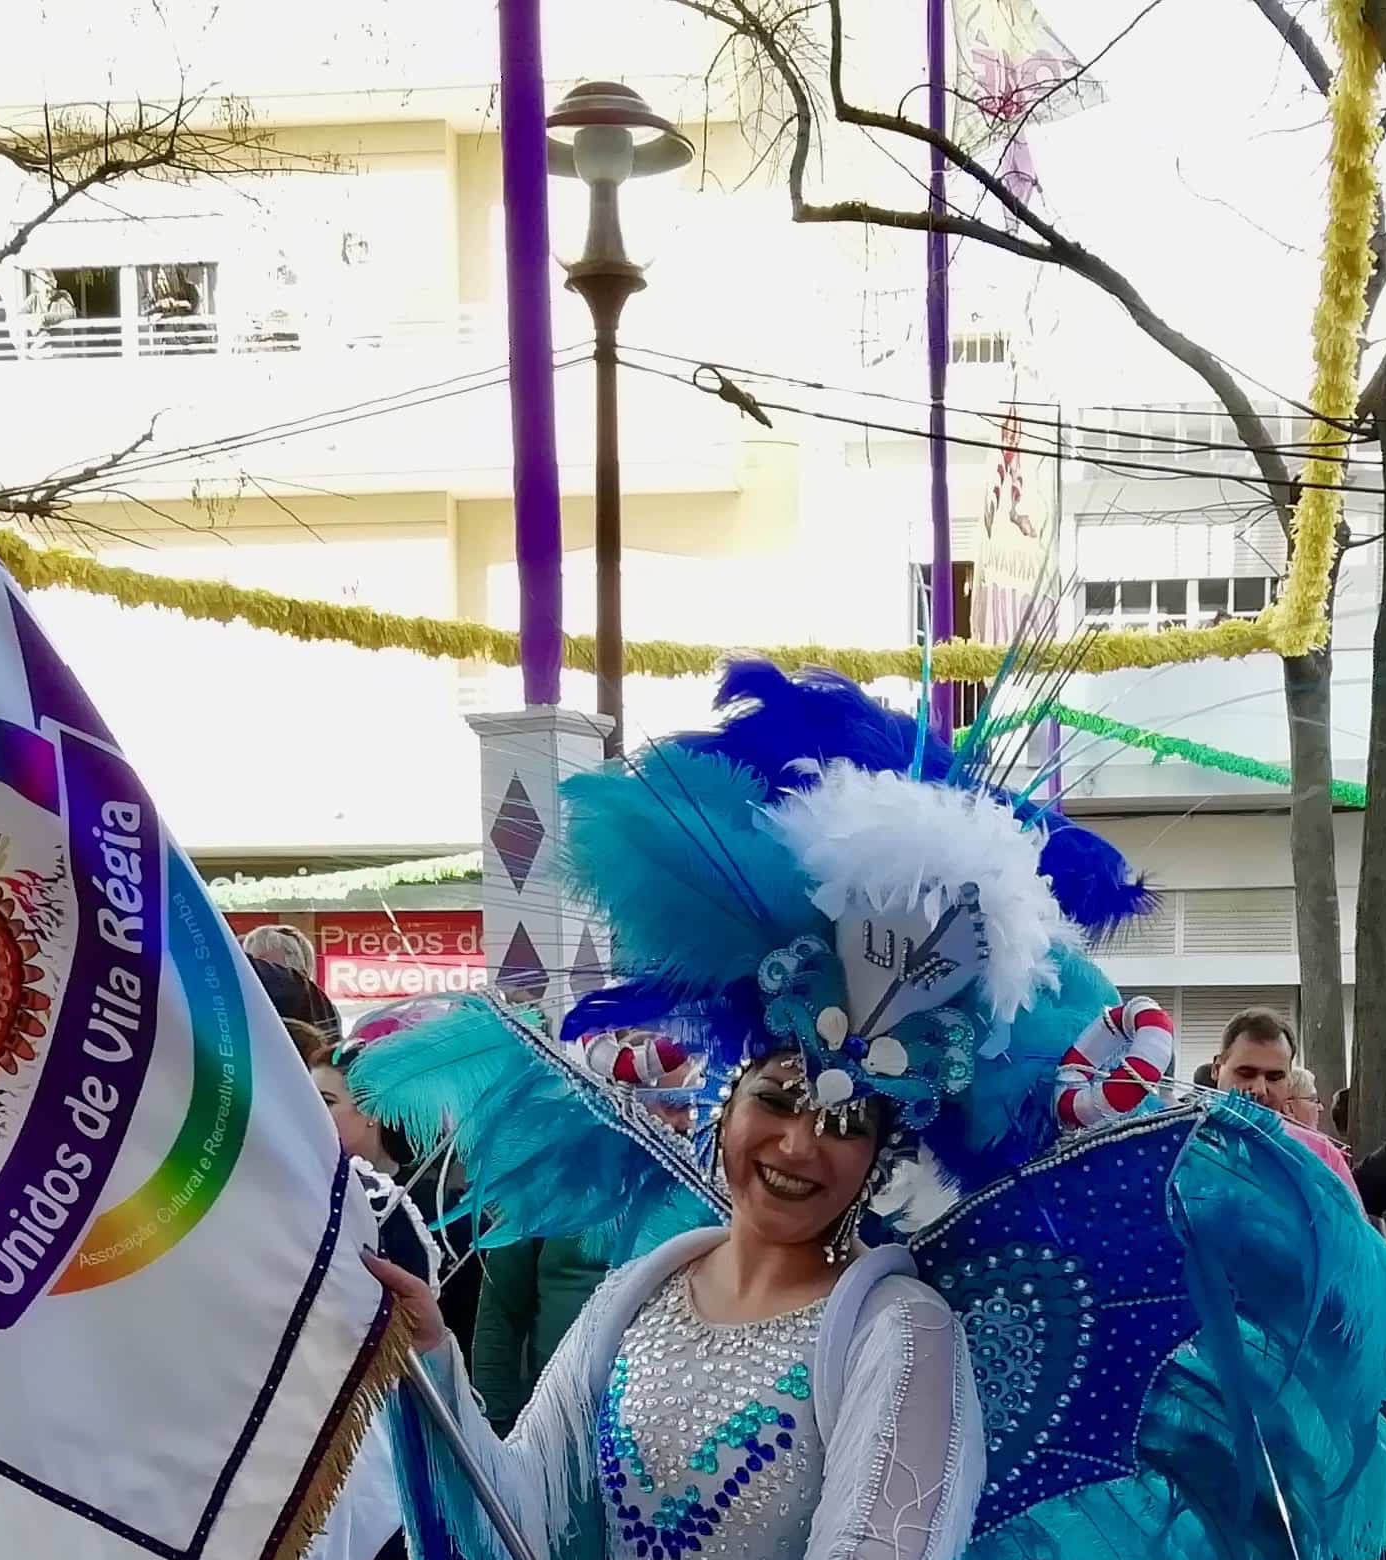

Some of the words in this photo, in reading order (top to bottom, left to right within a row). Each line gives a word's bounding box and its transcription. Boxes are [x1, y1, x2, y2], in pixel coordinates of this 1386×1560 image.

[92, 800, 144, 954] Régia
[172, 892, 210, 960] Samba
[321, 926, 443, 961] Preços
[329, 960, 487, 993] Revenda
[82, 966, 141, 1062] Vila
[213, 998, 234, 1057] Escola
[64, 1076, 119, 1140] de
[203, 1063, 235, 1156] Recreativa
[200, 1157, 212, 1170] e
[157, 1169, 205, 1224] Cultural
[78, 1221, 158, 1269] Associação
